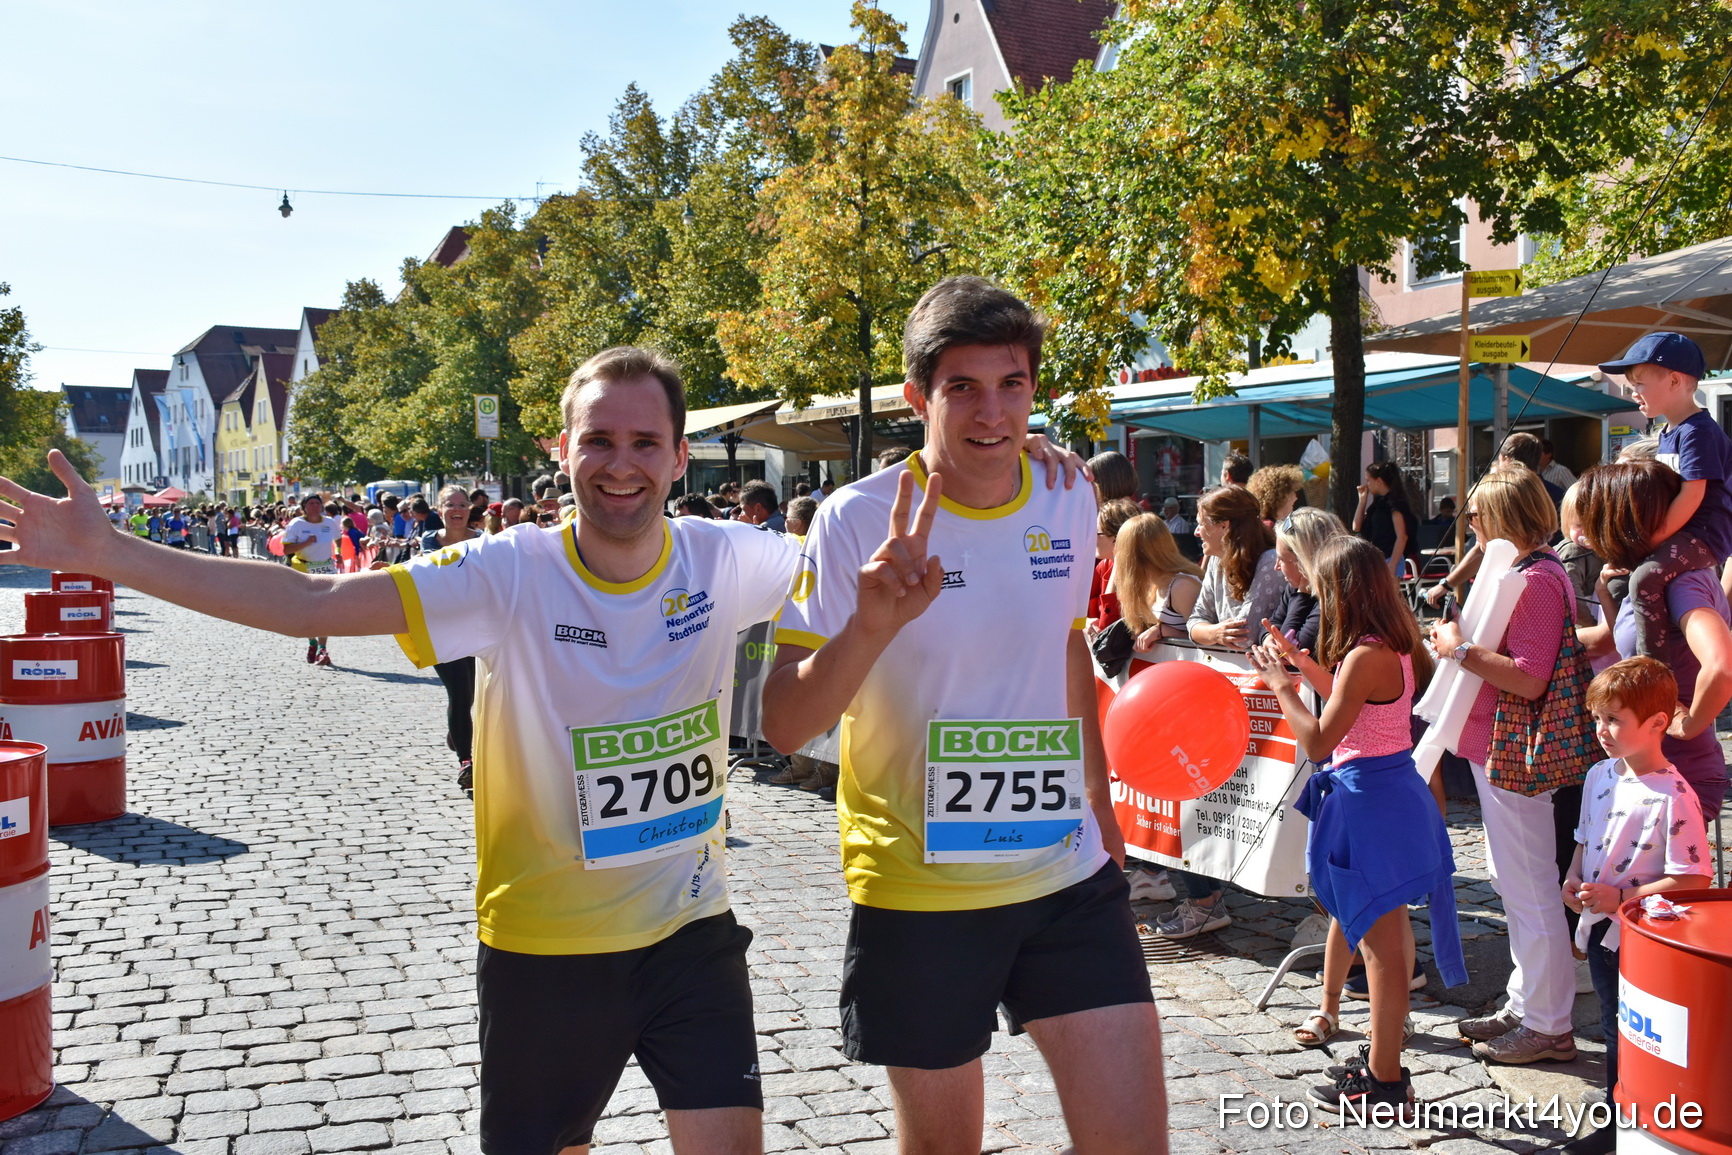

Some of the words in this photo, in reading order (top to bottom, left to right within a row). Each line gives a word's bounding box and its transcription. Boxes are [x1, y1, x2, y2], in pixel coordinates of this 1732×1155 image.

[1470, 275, 1512, 284] tartnummern-
[1476, 285, 1502, 296] ausgabe
[1474, 340, 1516, 349] Kleiderbeutel-
[1482, 350, 1508, 360] ausgabe
[1027, 533, 1050, 552] 20
[1052, 540, 1070, 549] JAHRE
[1029, 553, 1075, 566] Neumarkter
[1032, 567, 1071, 580] Stadtlauf
[663, 593, 690, 618] 20
[555, 625, 606, 644] BOCK
[668, 616, 710, 642] Stadtlauf
[1243, 697, 1278, 710] STEME
[1250, 720, 1272, 733] GEN
[586, 709, 710, 763] BOCK
[942, 727, 1069, 755] BOCK
[597, 753, 714, 819] 2709
[945, 769, 1067, 813] 2755
[1250, 783, 1256, 795] 8
[1136, 813, 1152, 830] Sicher
[1154, 820, 1162, 831] ist
[1162, 822, 1181, 837] sicher
[1195, 809, 1211, 822] Tel.
[1213, 811, 1235, 827] 09181
[639, 811, 709, 844] Christoph
[983, 828, 1024, 844] Luis
[1197, 822, 1212, 836] Fax
[1214, 825, 1235, 841] 09181
